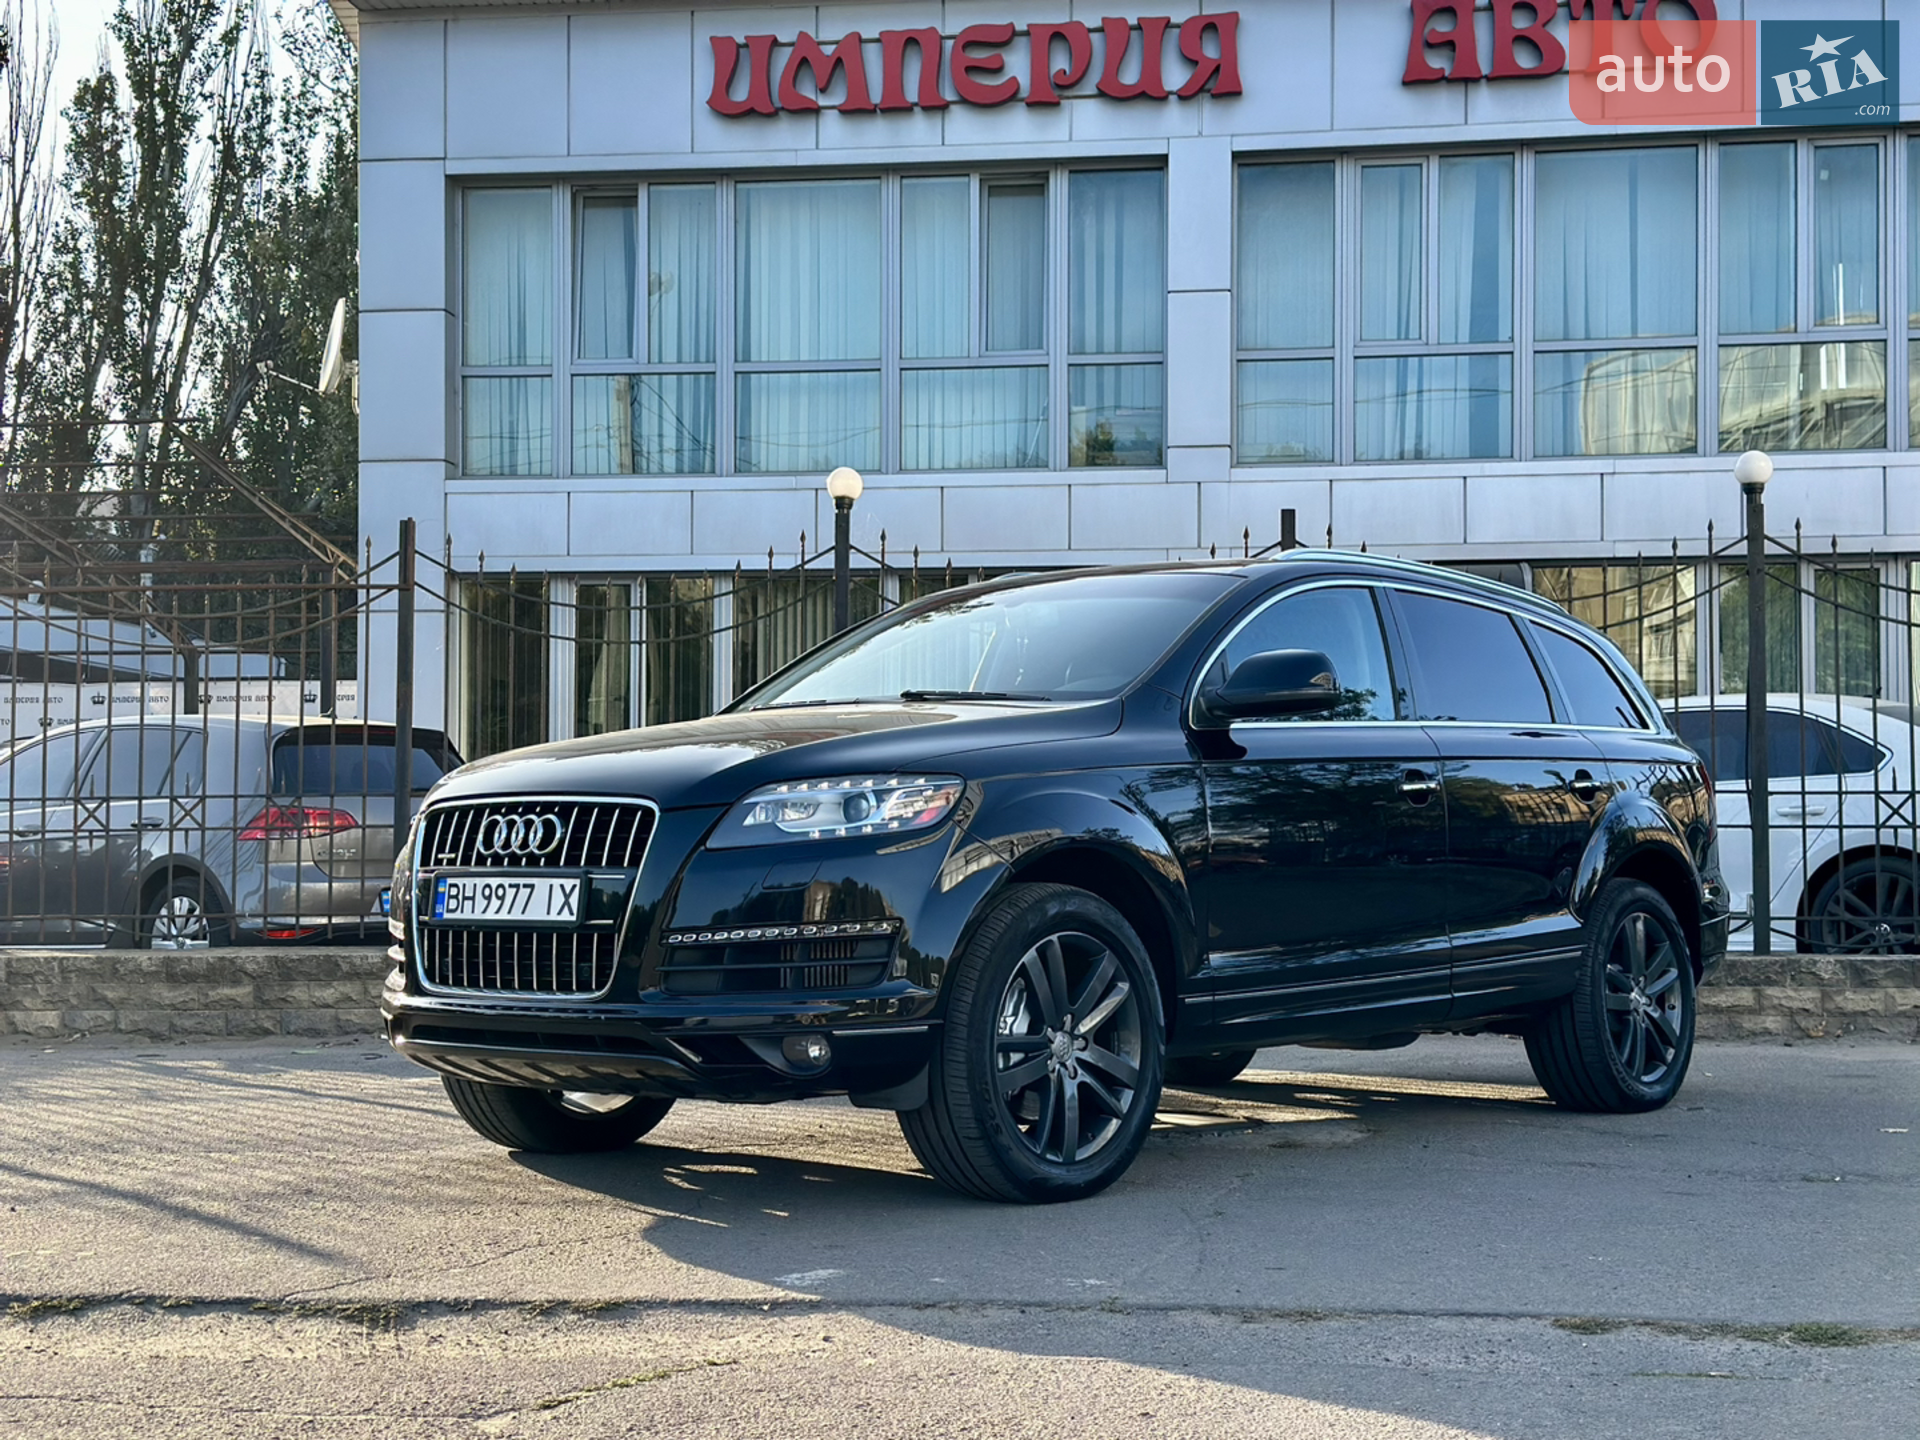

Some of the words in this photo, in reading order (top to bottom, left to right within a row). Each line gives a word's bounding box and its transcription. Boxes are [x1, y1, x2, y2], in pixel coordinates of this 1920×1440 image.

[706, 12, 1243, 118] ИМПЕРИЯ
[1402, 0, 1718, 85] АВТО
[546, 884, 578, 916] IX
